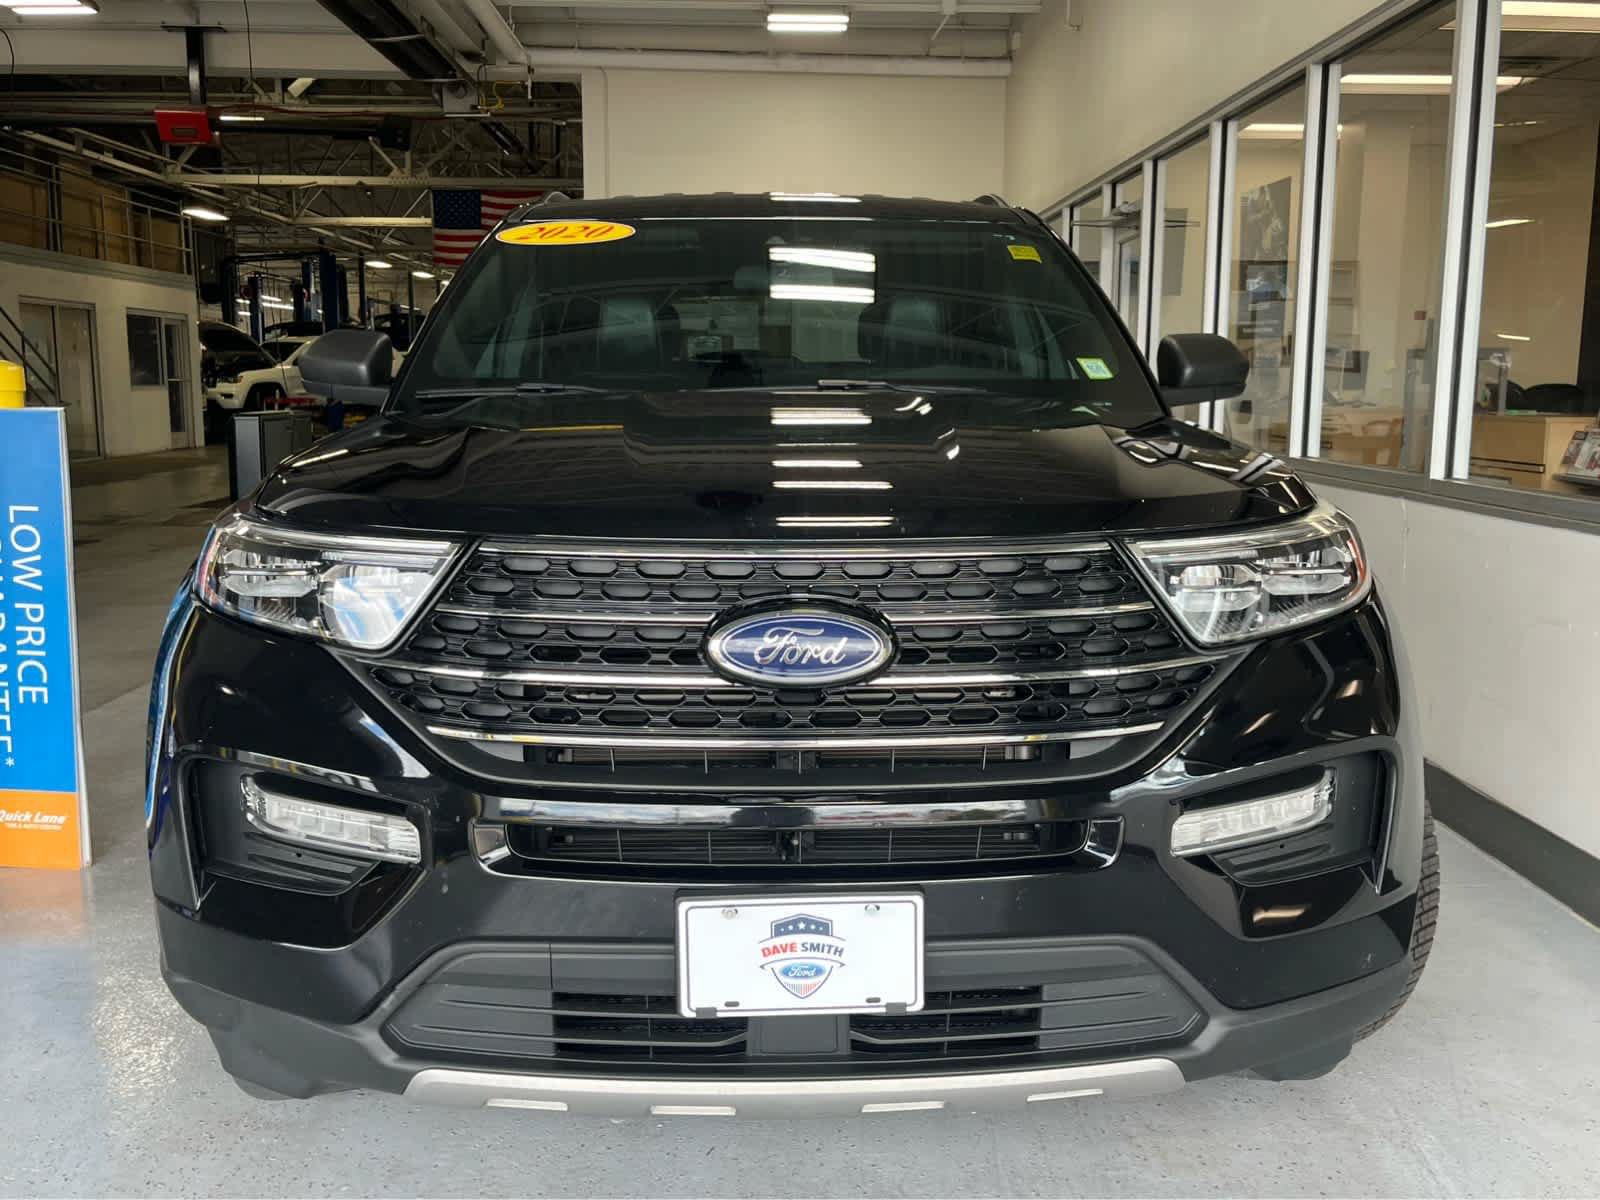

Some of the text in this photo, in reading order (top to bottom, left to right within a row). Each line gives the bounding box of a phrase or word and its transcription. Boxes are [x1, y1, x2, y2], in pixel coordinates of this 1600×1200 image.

[515, 225, 614, 240] 2020
[9, 505, 48, 704] LOW PRICE
[754, 627, 848, 665] Ford
[33, 811, 65, 824] Lane
[761, 942, 844, 957] DAVE SMITH
[788, 965, 817, 977] Ford
